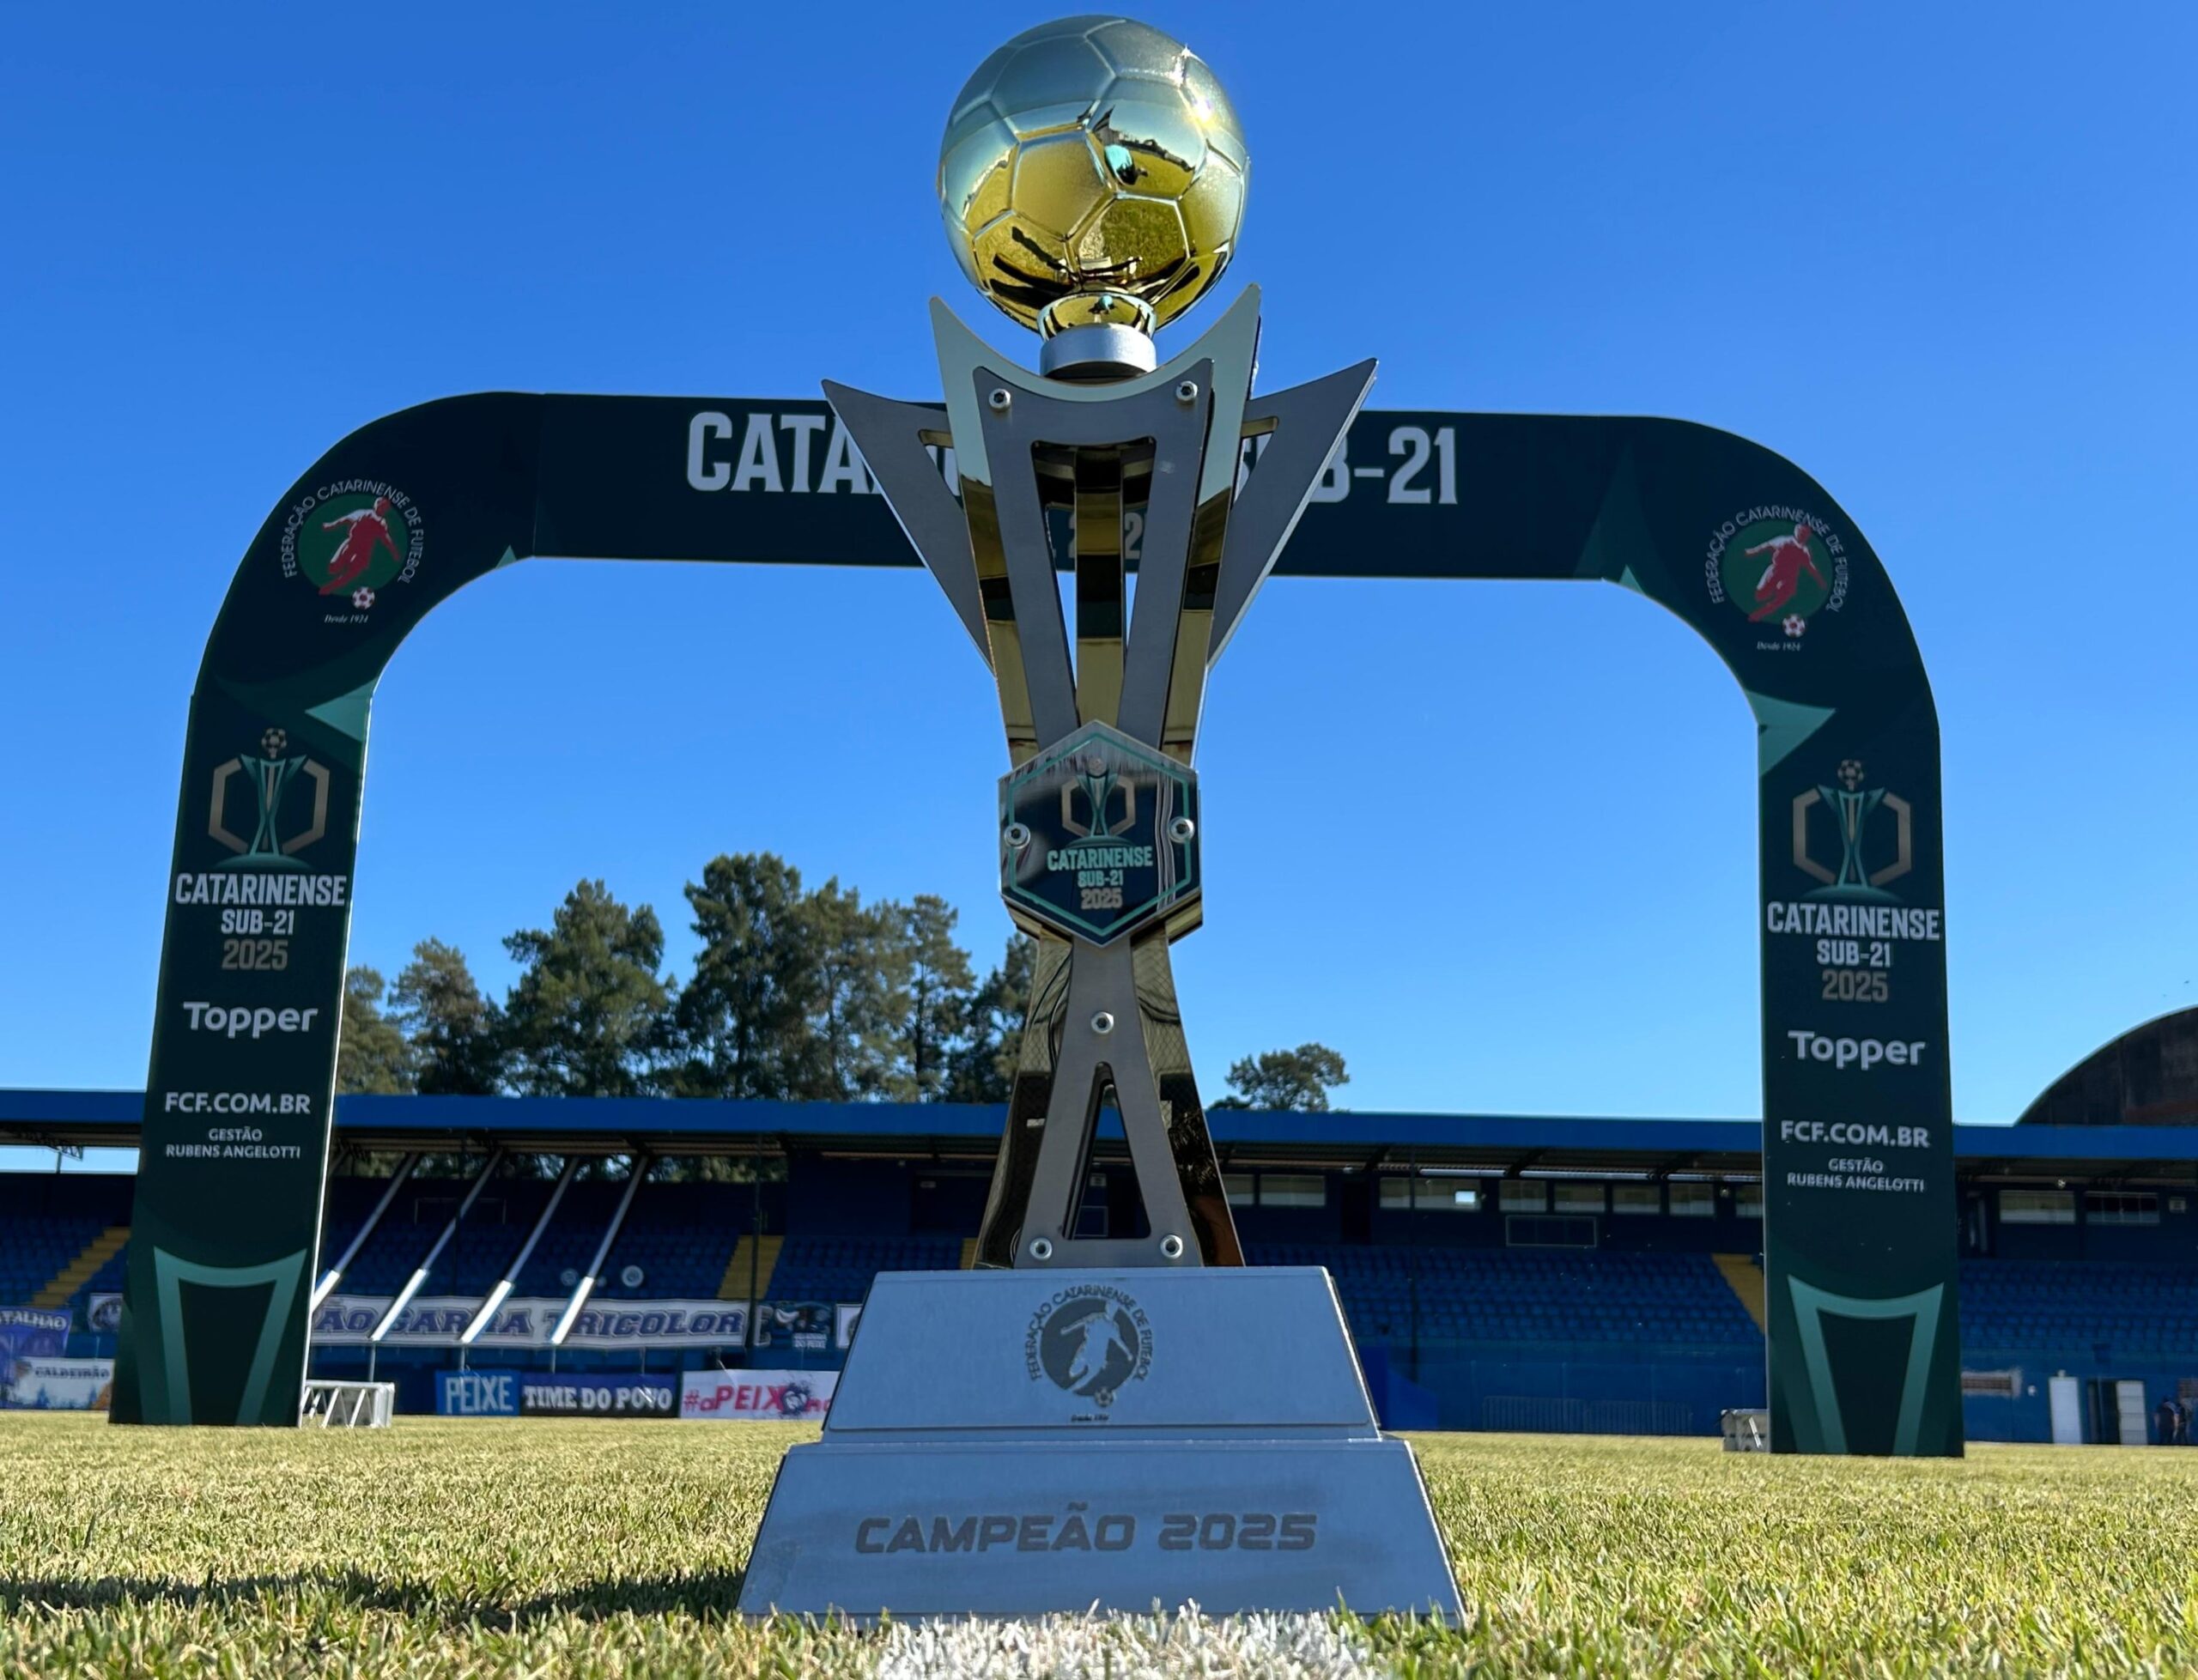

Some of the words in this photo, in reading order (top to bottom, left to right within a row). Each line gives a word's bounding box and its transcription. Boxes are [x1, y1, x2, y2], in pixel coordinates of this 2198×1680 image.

[317, 478, 410, 509] CATARINENSE
[404, 506, 422, 527] DE
[1735, 505, 1831, 537] CATARINENSE
[282, 496, 316, 579] FEDERAÇÃO
[1825, 534, 1844, 555] DE
[397, 529, 424, 584] FUTEBOL
[1705, 521, 1736, 603] FEDERAÇÃO
[1825, 556, 1849, 612] FUTEBOL
[1047, 846, 1153, 871] CATARINENSE
[175, 872, 347, 907] CATARINENSE
[1078, 869, 1124, 888] SUB-21
[1080, 888, 1122, 910] 2025
[221, 909, 294, 936] SUB-21
[1767, 901, 1940, 941] CATARINENSE
[222, 939, 288, 971] 2025
[1817, 939, 1891, 967] SUB-21
[1821, 968, 1889, 1003] 2025
[183, 1001, 319, 1040] Topper
[1788, 1030, 1926, 1070] Topper
[165, 1092, 311, 1114] FCF.COM.BR
[209, 1125, 263, 1142] GESTÃO
[1781, 1119, 1930, 1148] FCF.COM.BR
[166, 1144, 221, 1158] RUBENS
[223, 1145, 301, 1159] ANGELOTTI
[1828, 1157, 1884, 1174] GESTÃO
[1787, 1173, 1843, 1189] RUBENS
[1845, 1176, 1925, 1193] ANGELOTTI
[1052, 1284, 1136, 1310] CATARINENSE
[1132, 1307, 1149, 1327] DE
[1025, 1302, 1053, 1380] FEDERAÇÃO
[1132, 1327, 1153, 1380] FUTEBOL
[34, 1365, 110, 1380] CALDEIRÃO
[446, 1375, 513, 1414] PEIXE
[523, 1385, 577, 1410] TIME
[580, 1386, 610, 1410] DO
[616, 1386, 673, 1410] POVO
[855, 1501, 1137, 1554] CAMPEÃO
[1158, 1513, 1318, 1551] 2025
